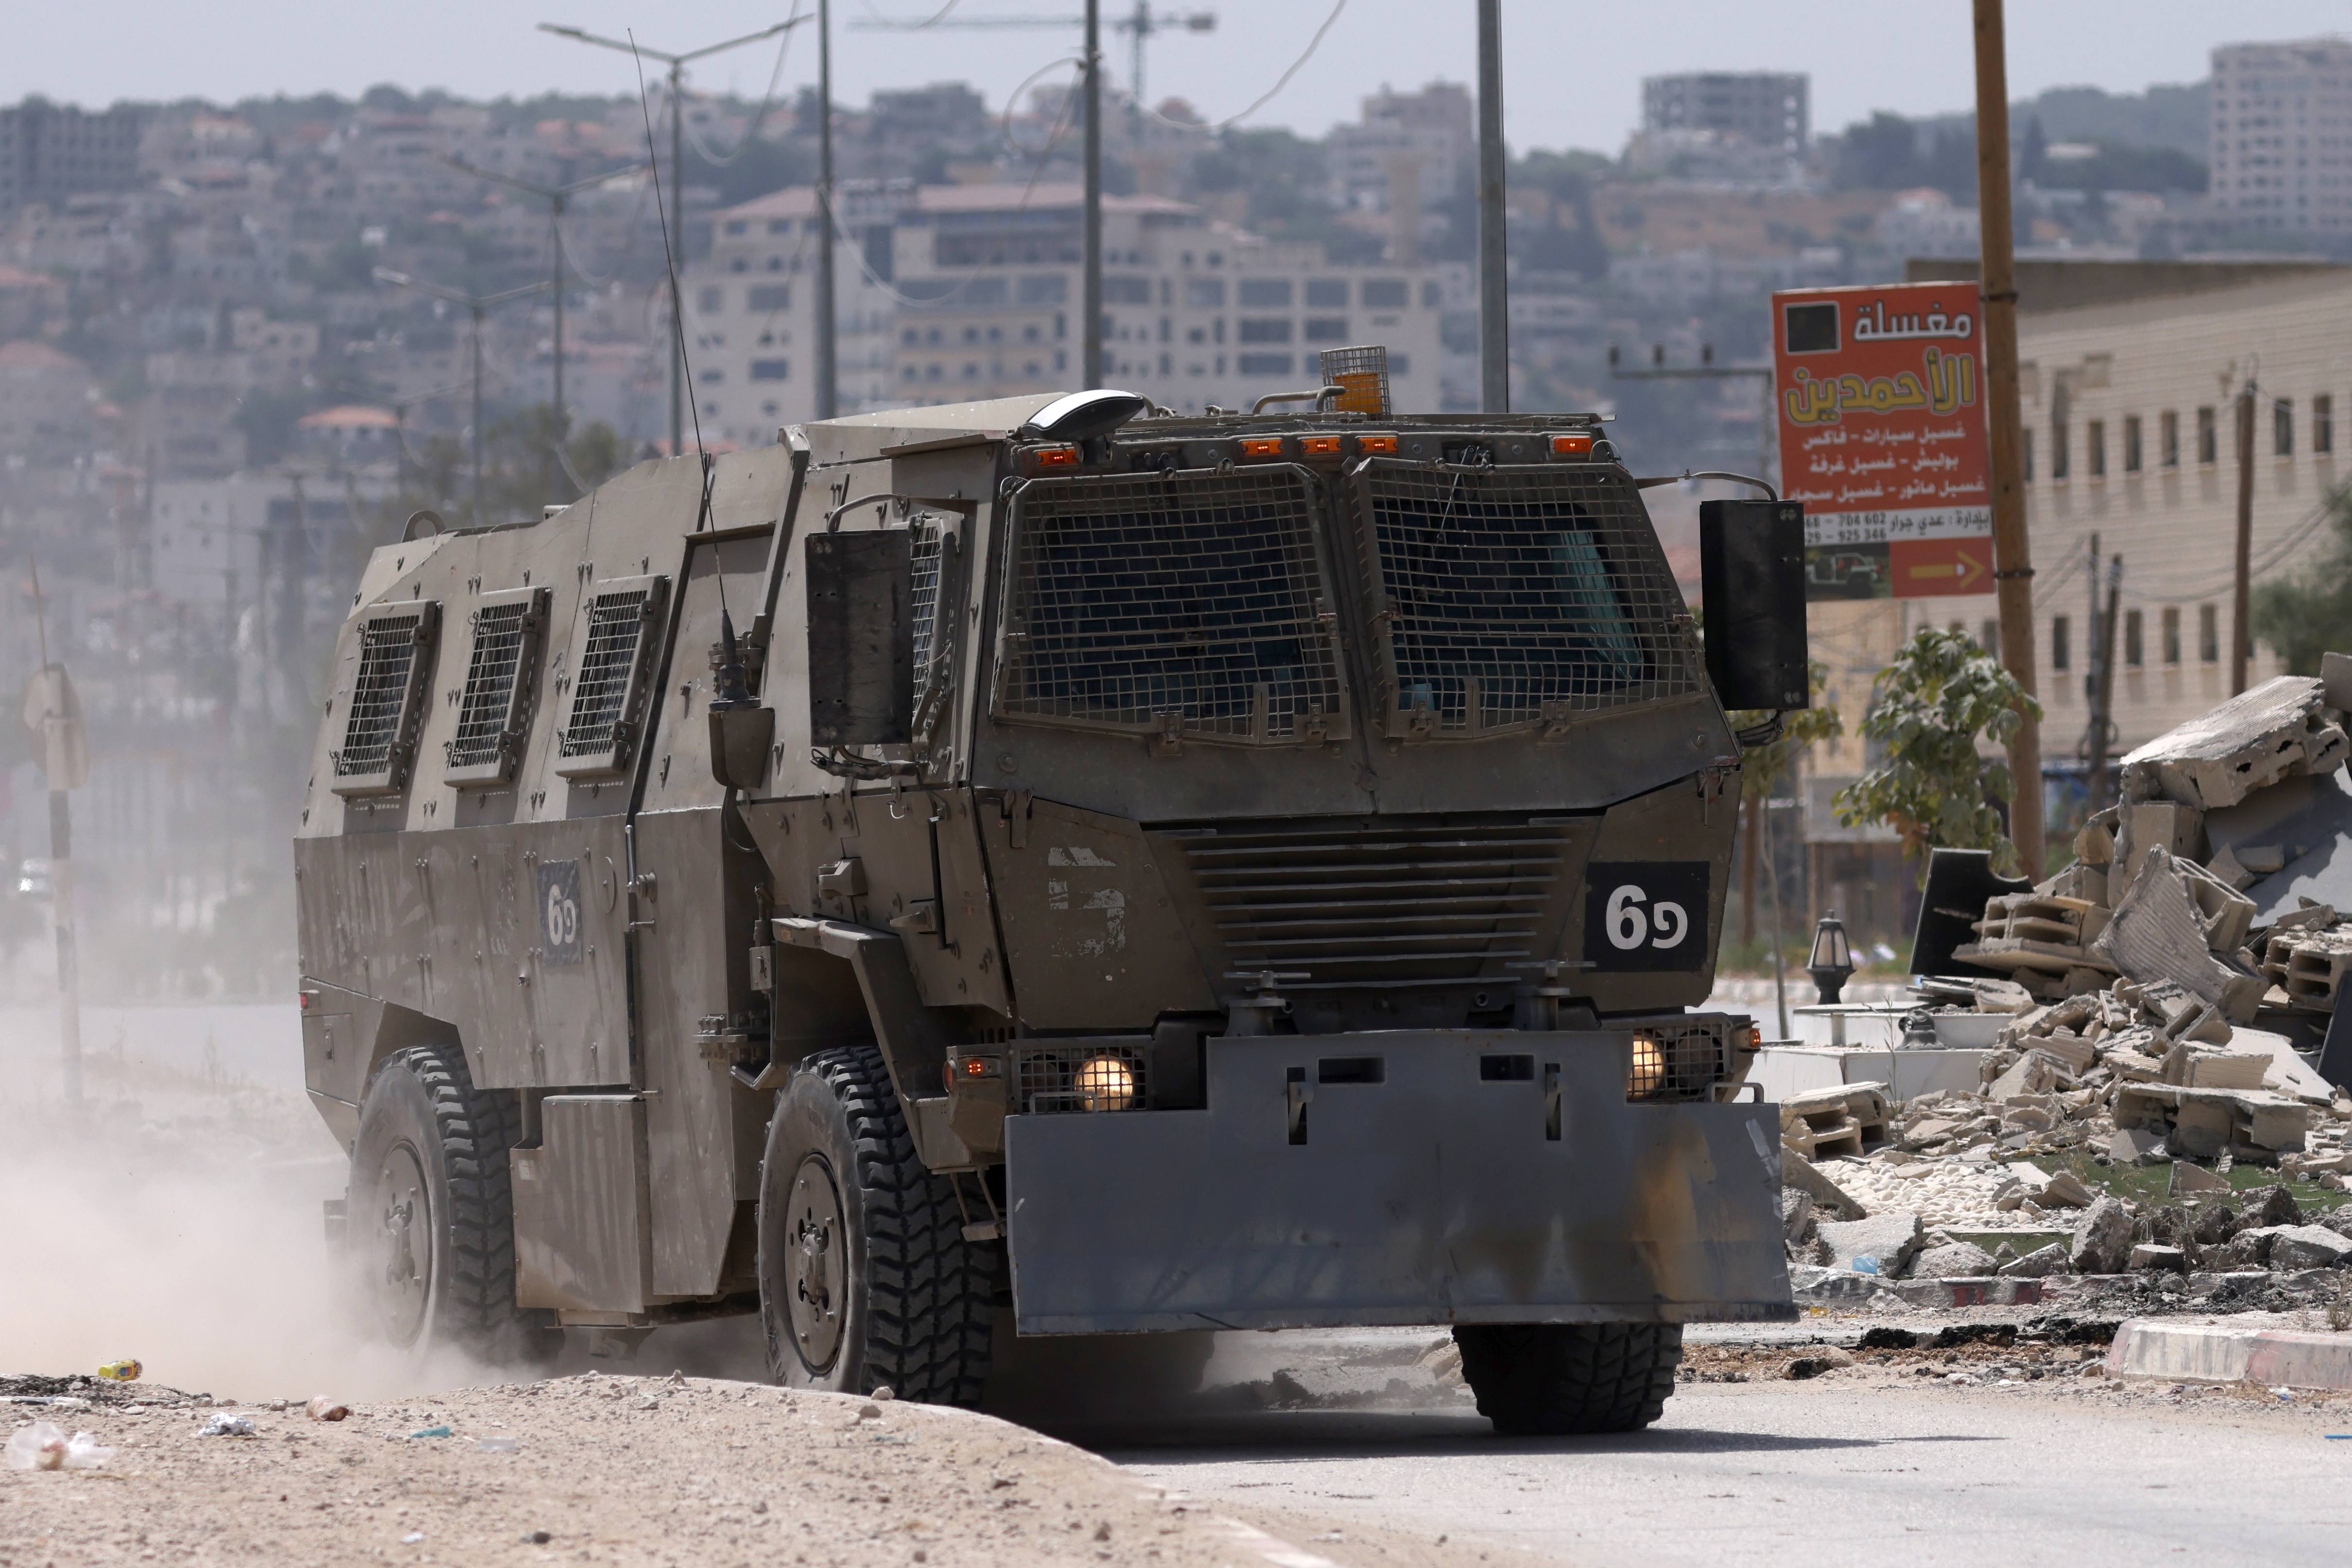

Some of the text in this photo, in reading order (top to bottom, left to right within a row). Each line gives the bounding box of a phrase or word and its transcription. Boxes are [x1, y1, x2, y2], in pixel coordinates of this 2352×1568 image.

[1853, 300, 1973, 342] مغسلة
[1786, 346, 1974, 424] الأحمدين
[1863, 427, 1915, 447] سيارات
[1919, 421, 1965, 445] غسيل
[1848, 451, 1896, 476] غسيل
[1912, 447, 1960, 472] بوليش
[1836, 479, 1884, 503] غسيل
[1938, 474, 1986, 499] غسيل
